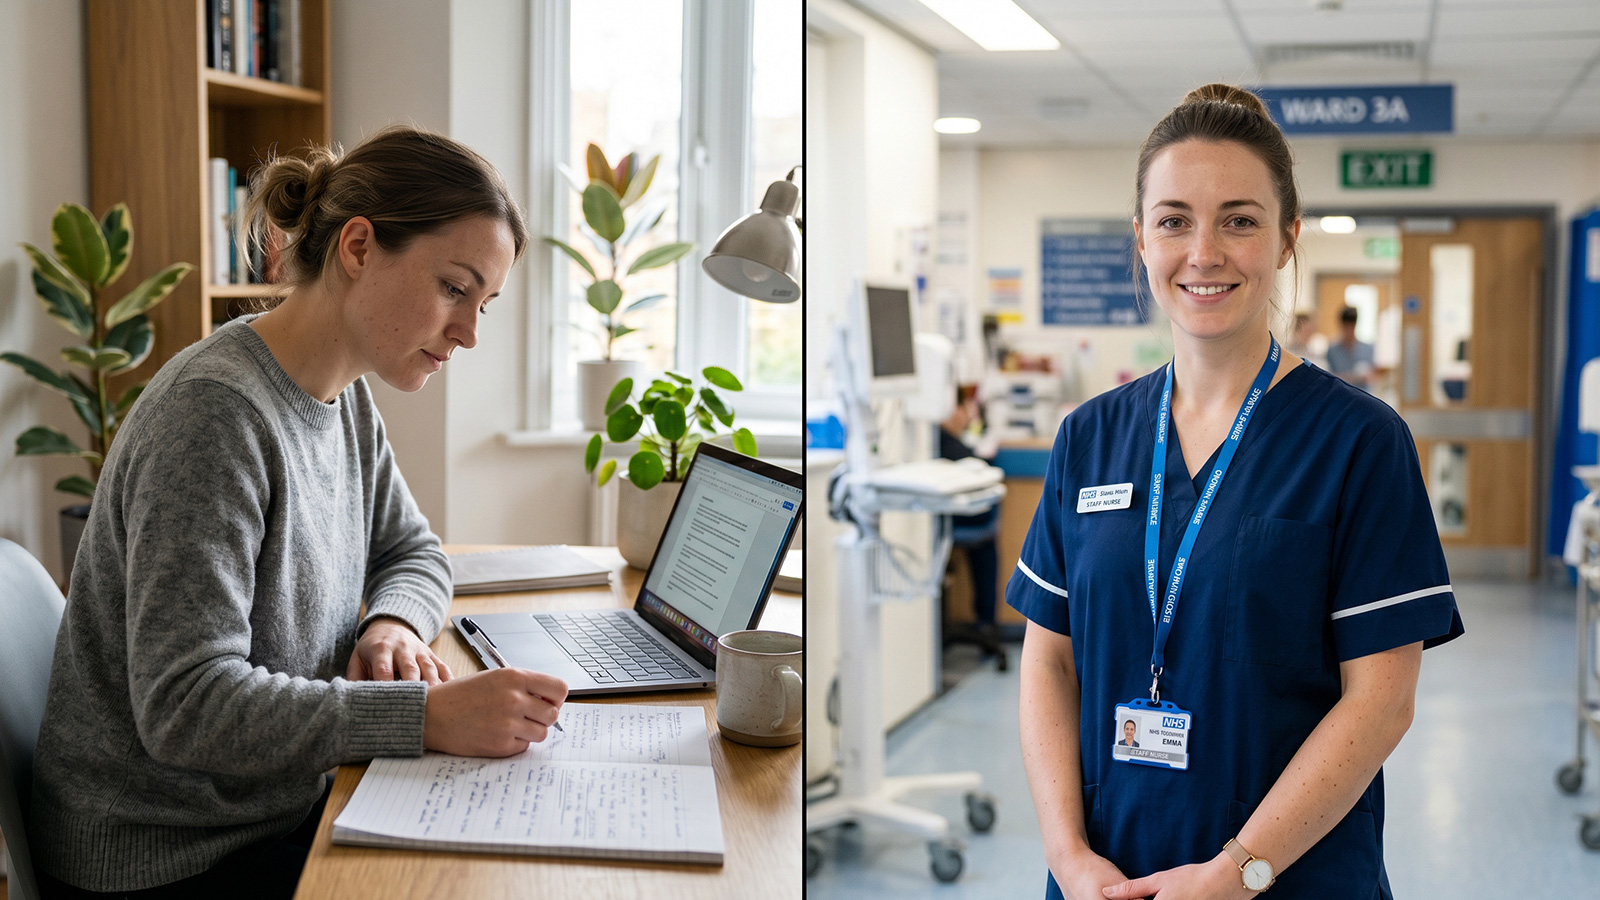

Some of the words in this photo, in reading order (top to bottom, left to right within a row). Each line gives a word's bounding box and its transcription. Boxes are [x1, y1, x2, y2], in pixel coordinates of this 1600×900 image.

[1280, 97, 1367, 125] WARD
[1370, 96, 1410, 124] 3A
[1349, 155, 1422, 185] EXIT
[1103, 498, 1121, 506] NURSE
[1163, 717, 1185, 729] NHS
[1162, 738, 1182, 747] EMMA
[1129, 748, 1149, 757] STAFF
[1150, 752, 1169, 760] NURSE
